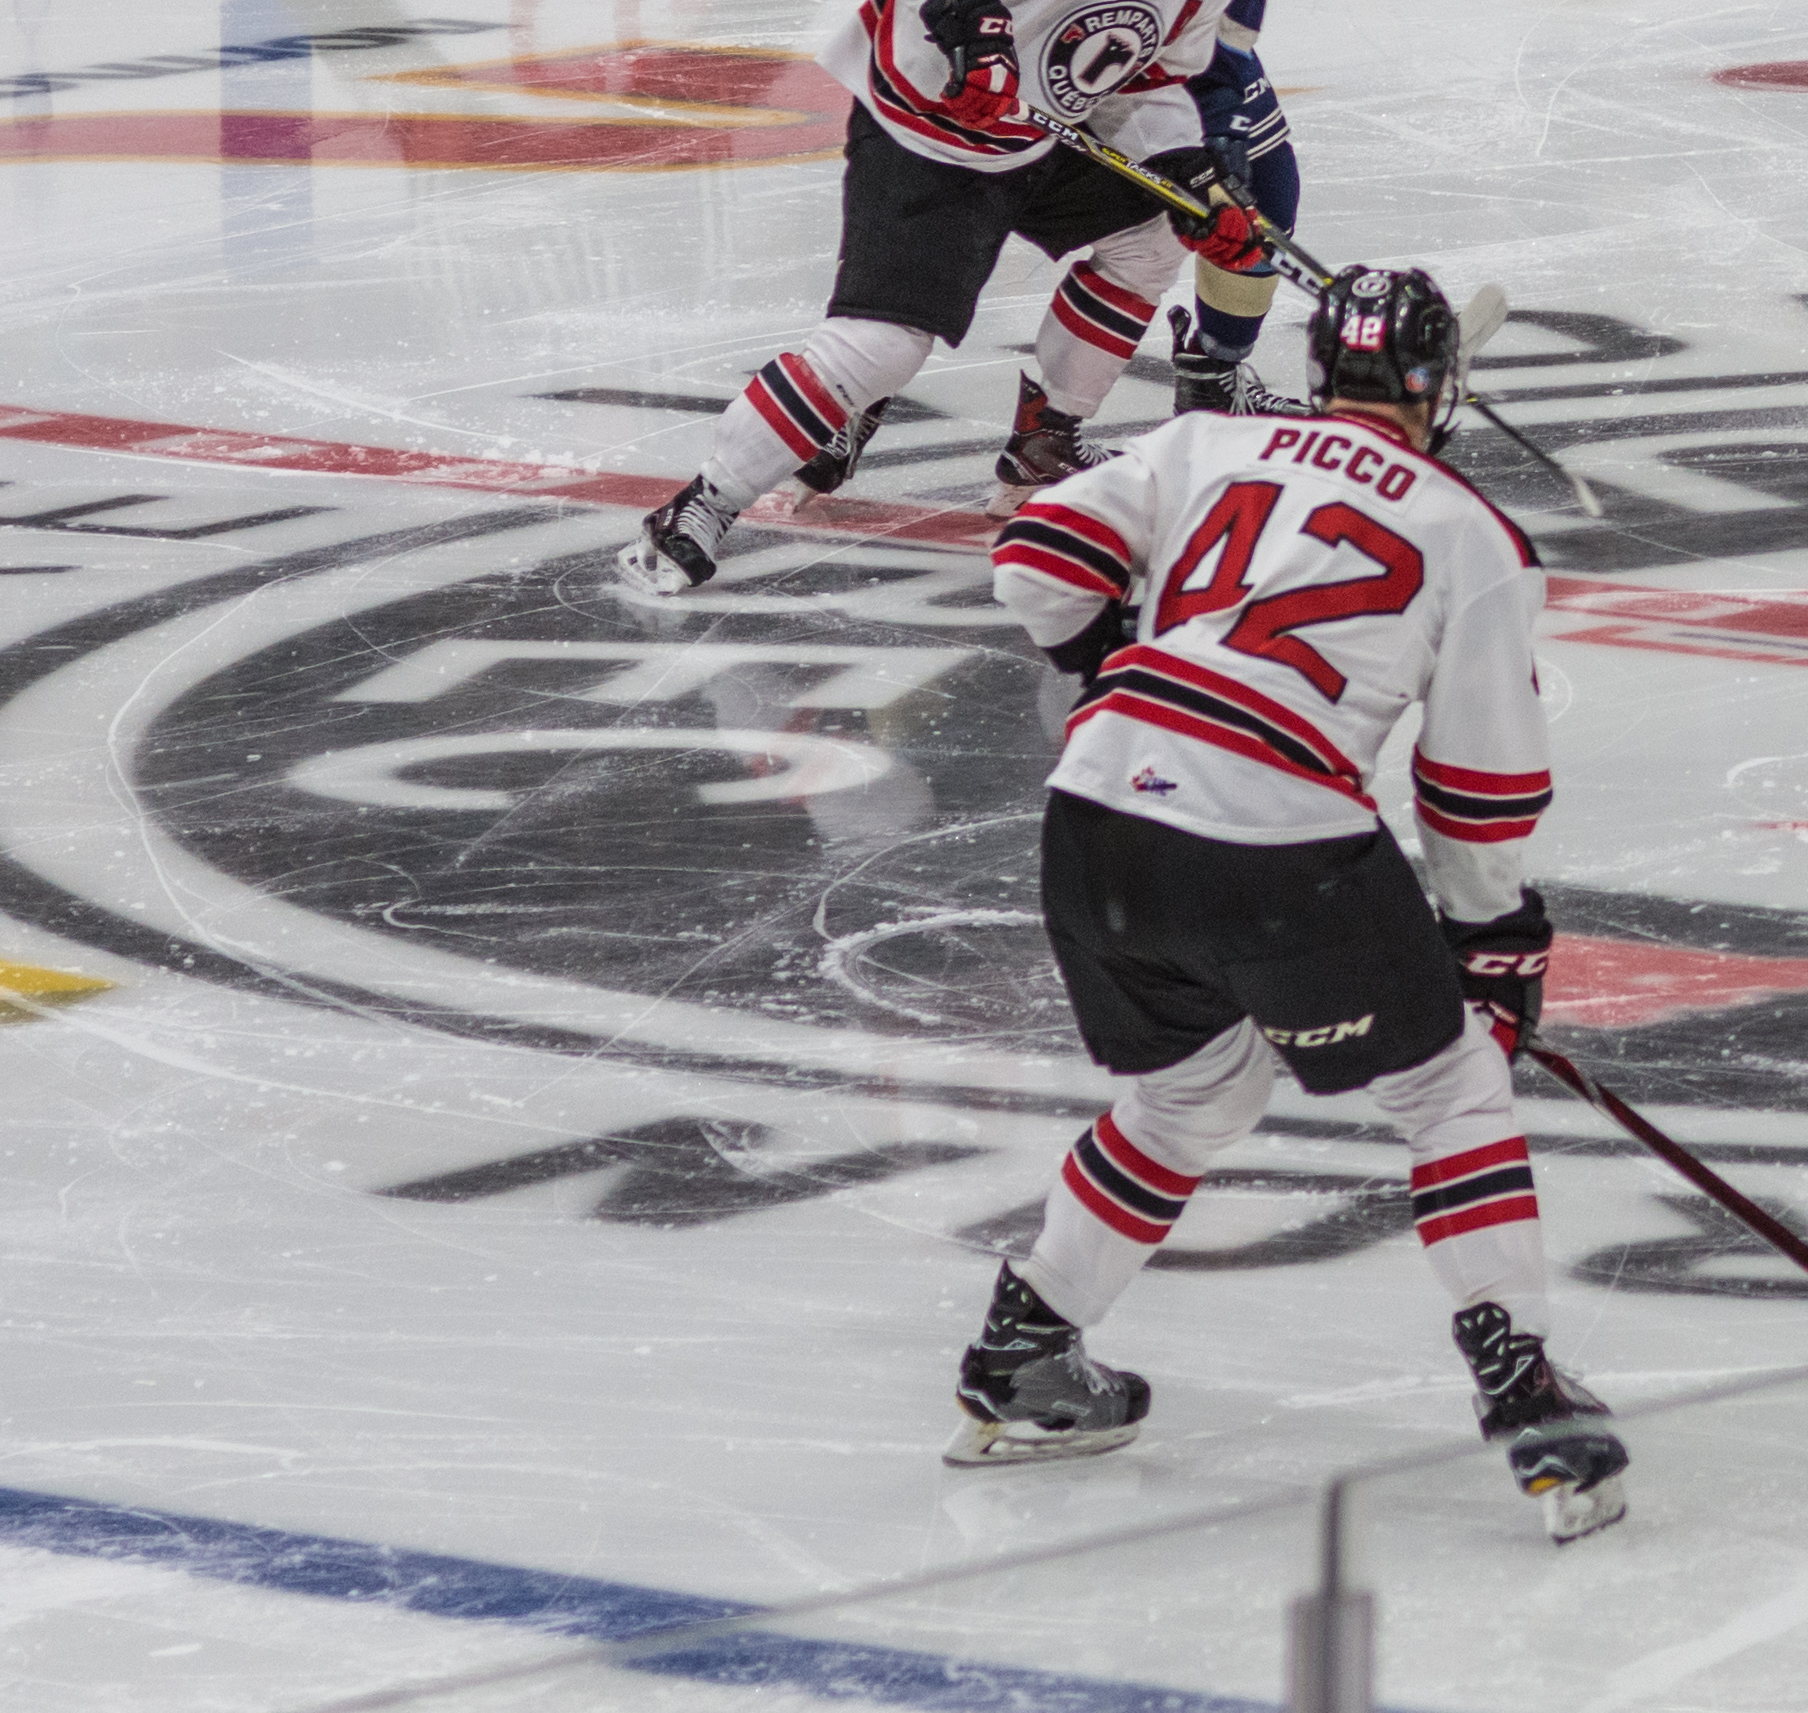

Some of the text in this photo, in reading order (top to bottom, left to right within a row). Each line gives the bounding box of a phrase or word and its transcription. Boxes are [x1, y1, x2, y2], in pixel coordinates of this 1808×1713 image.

[1341, 315, 1387, 350] 42
[1259, 427, 1418, 502] PICCO
[1154, 480, 1425, 705] 42
